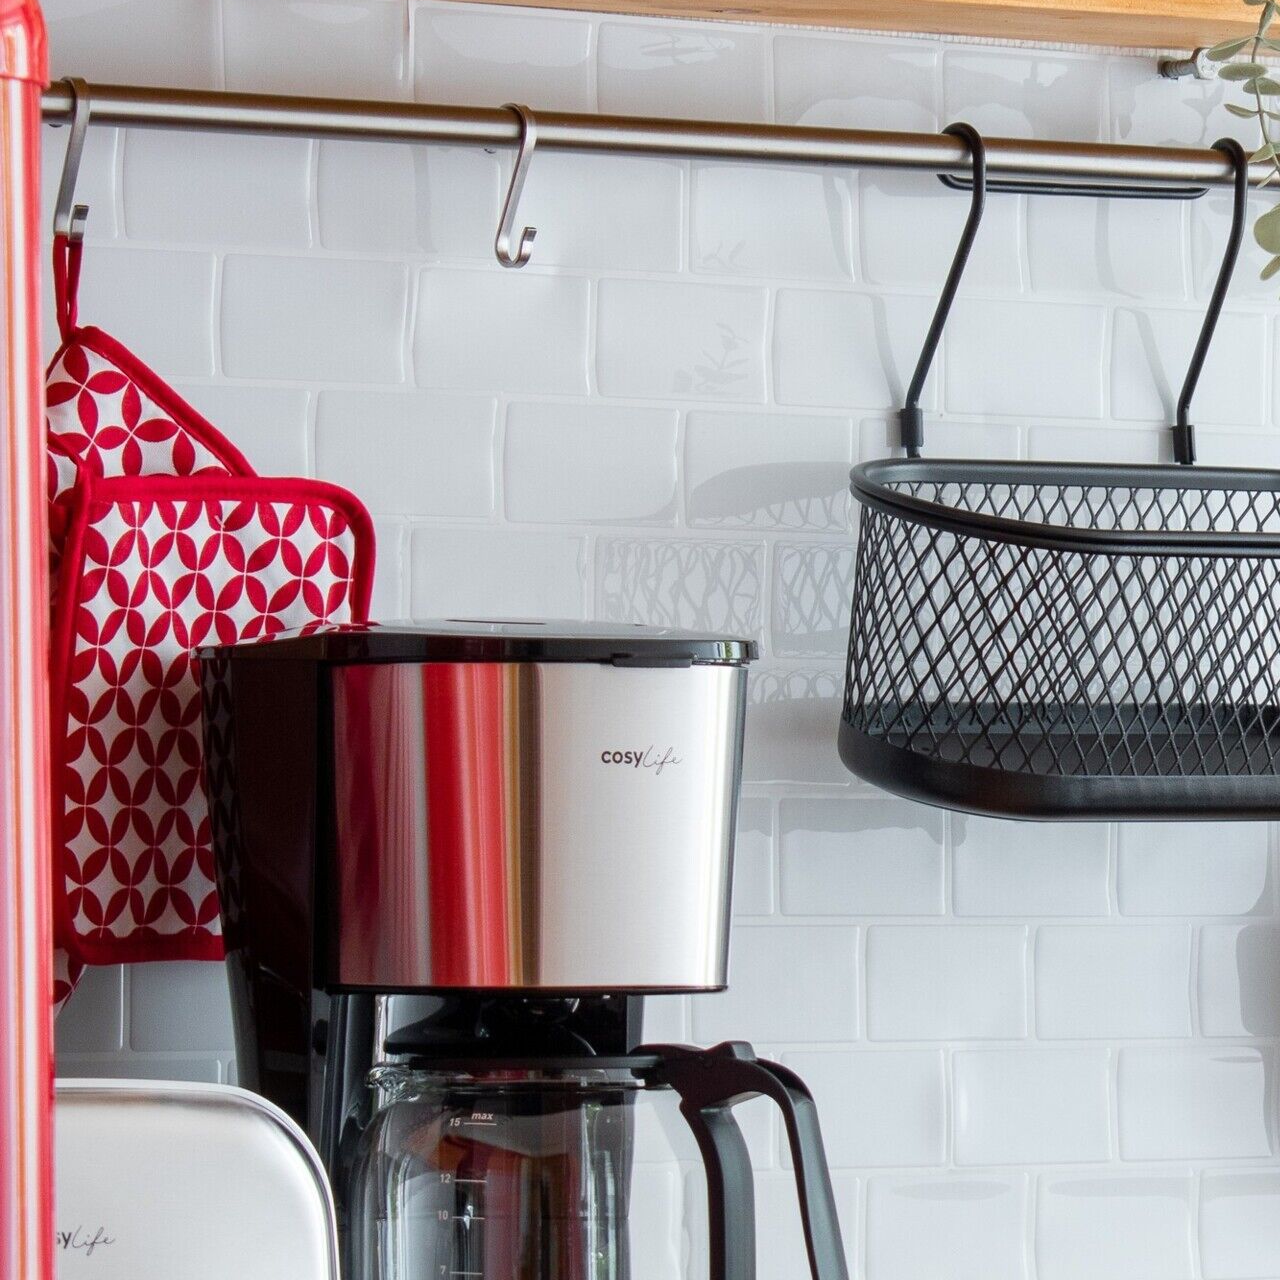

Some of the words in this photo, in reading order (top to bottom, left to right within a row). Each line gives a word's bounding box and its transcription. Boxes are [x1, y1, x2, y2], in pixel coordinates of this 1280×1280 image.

[449, 1117, 461, 1126] 15
[471, 1112, 494, 1120] max
[440, 1173, 451, 1183] 12
[438, 1210, 449, 1220] 10
[440, 1265, 446, 1275] 7
